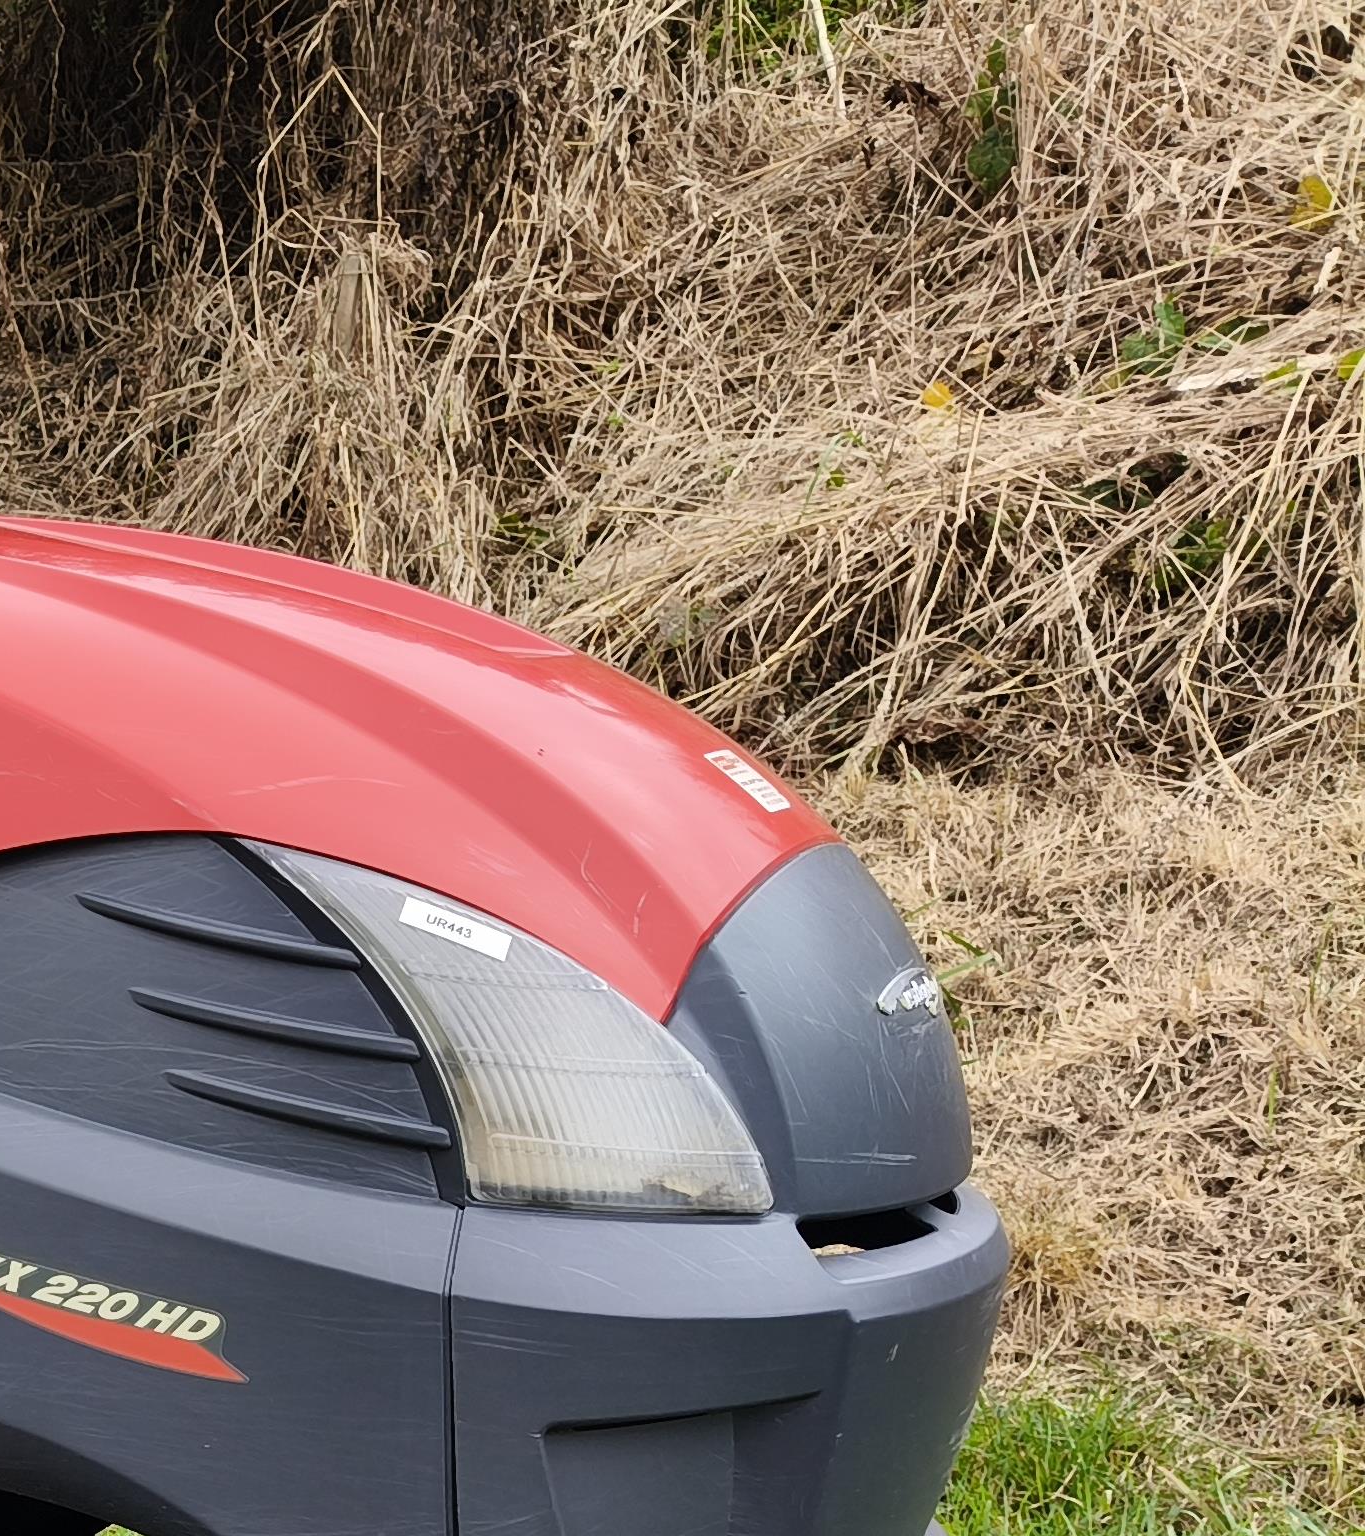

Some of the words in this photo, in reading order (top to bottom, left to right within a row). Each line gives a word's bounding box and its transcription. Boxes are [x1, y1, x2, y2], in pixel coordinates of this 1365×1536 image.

[426, 913, 473, 940] UR443
[30, 1274, 139, 1321] 220
[133, 1300, 221, 1342] HD
